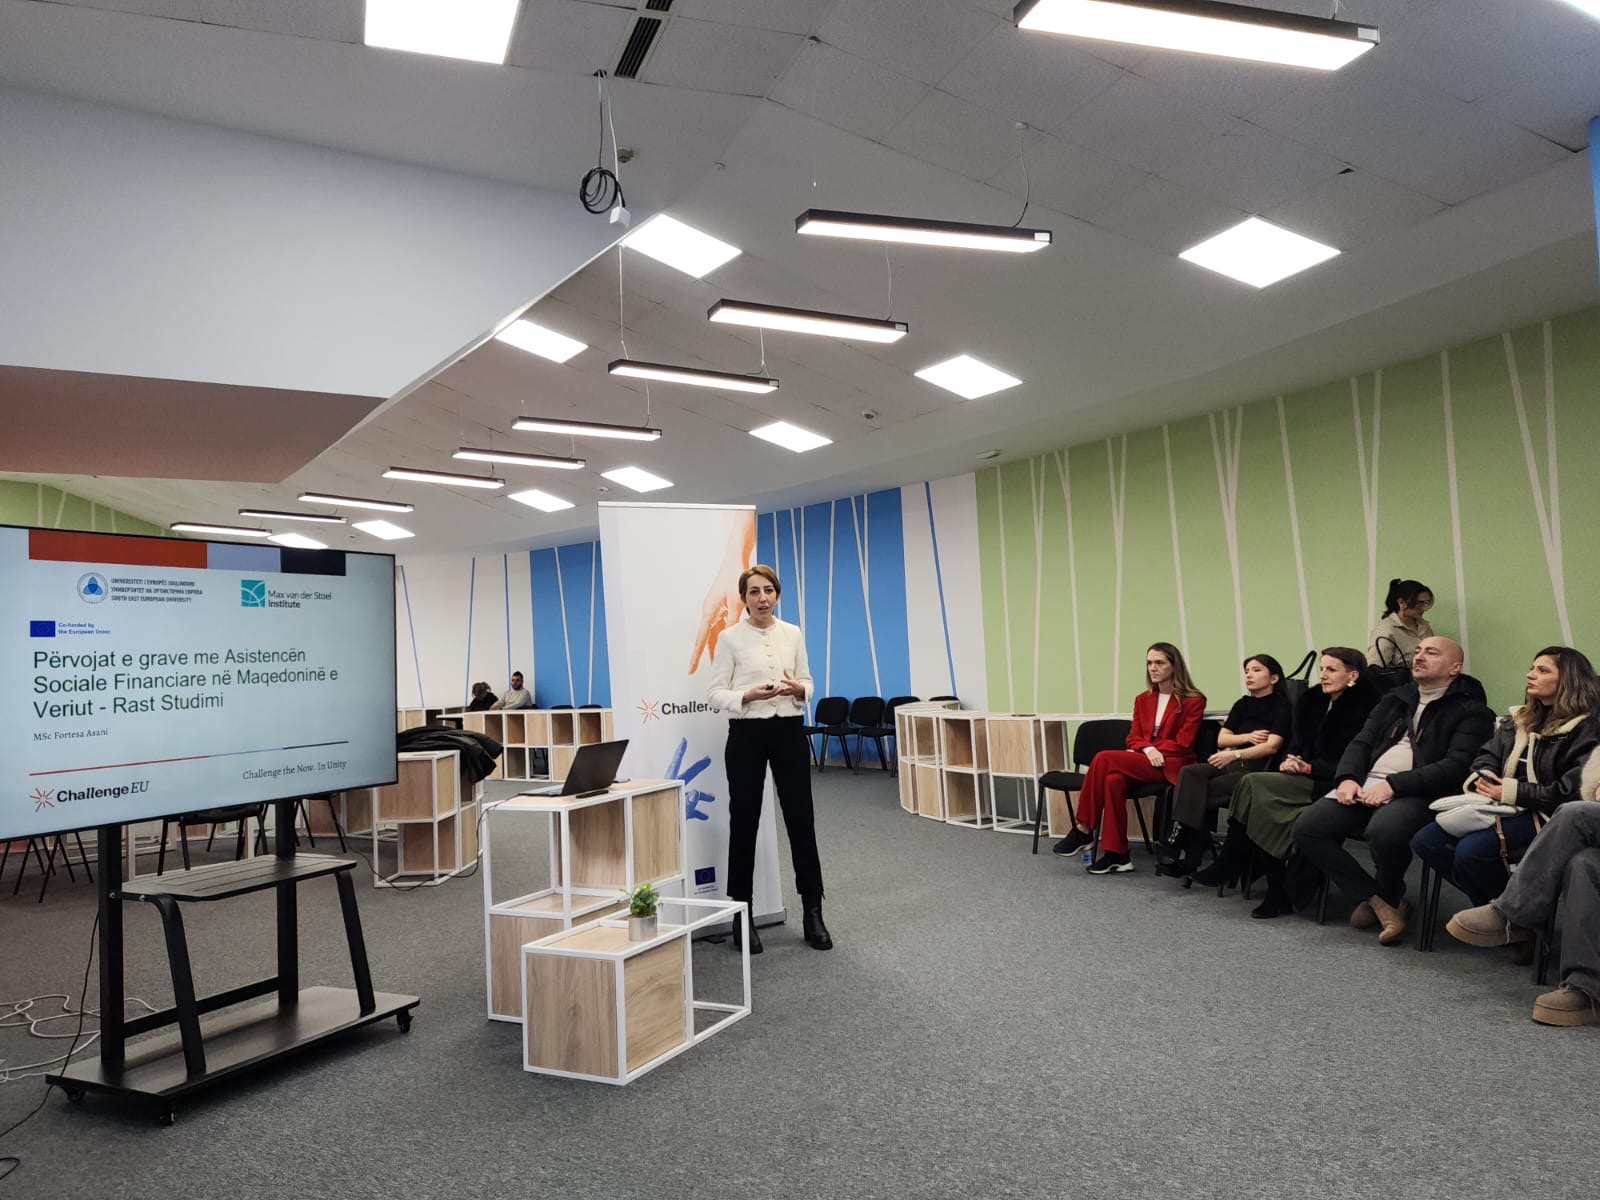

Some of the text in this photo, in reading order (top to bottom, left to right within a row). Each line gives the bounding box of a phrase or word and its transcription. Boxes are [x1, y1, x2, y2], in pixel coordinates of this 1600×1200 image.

[268, 590, 284, 598] Max
[314, 592, 332, 600] Stoel
[268, 600, 300, 608] Institute
[34, 648, 306, 672] Përvojat e grave me Asistencën
[34, 667, 338, 694] Sociale Financiare në Maqedoninë e
[33, 700, 93, 718] Veriut
[113, 696, 155, 714] Rast
[161, 692, 224, 710] Studimi
[33, 728, 108, 741] MSc Fortesa Asani
[242, 760, 347, 780] Challenge the Now. In Unity
